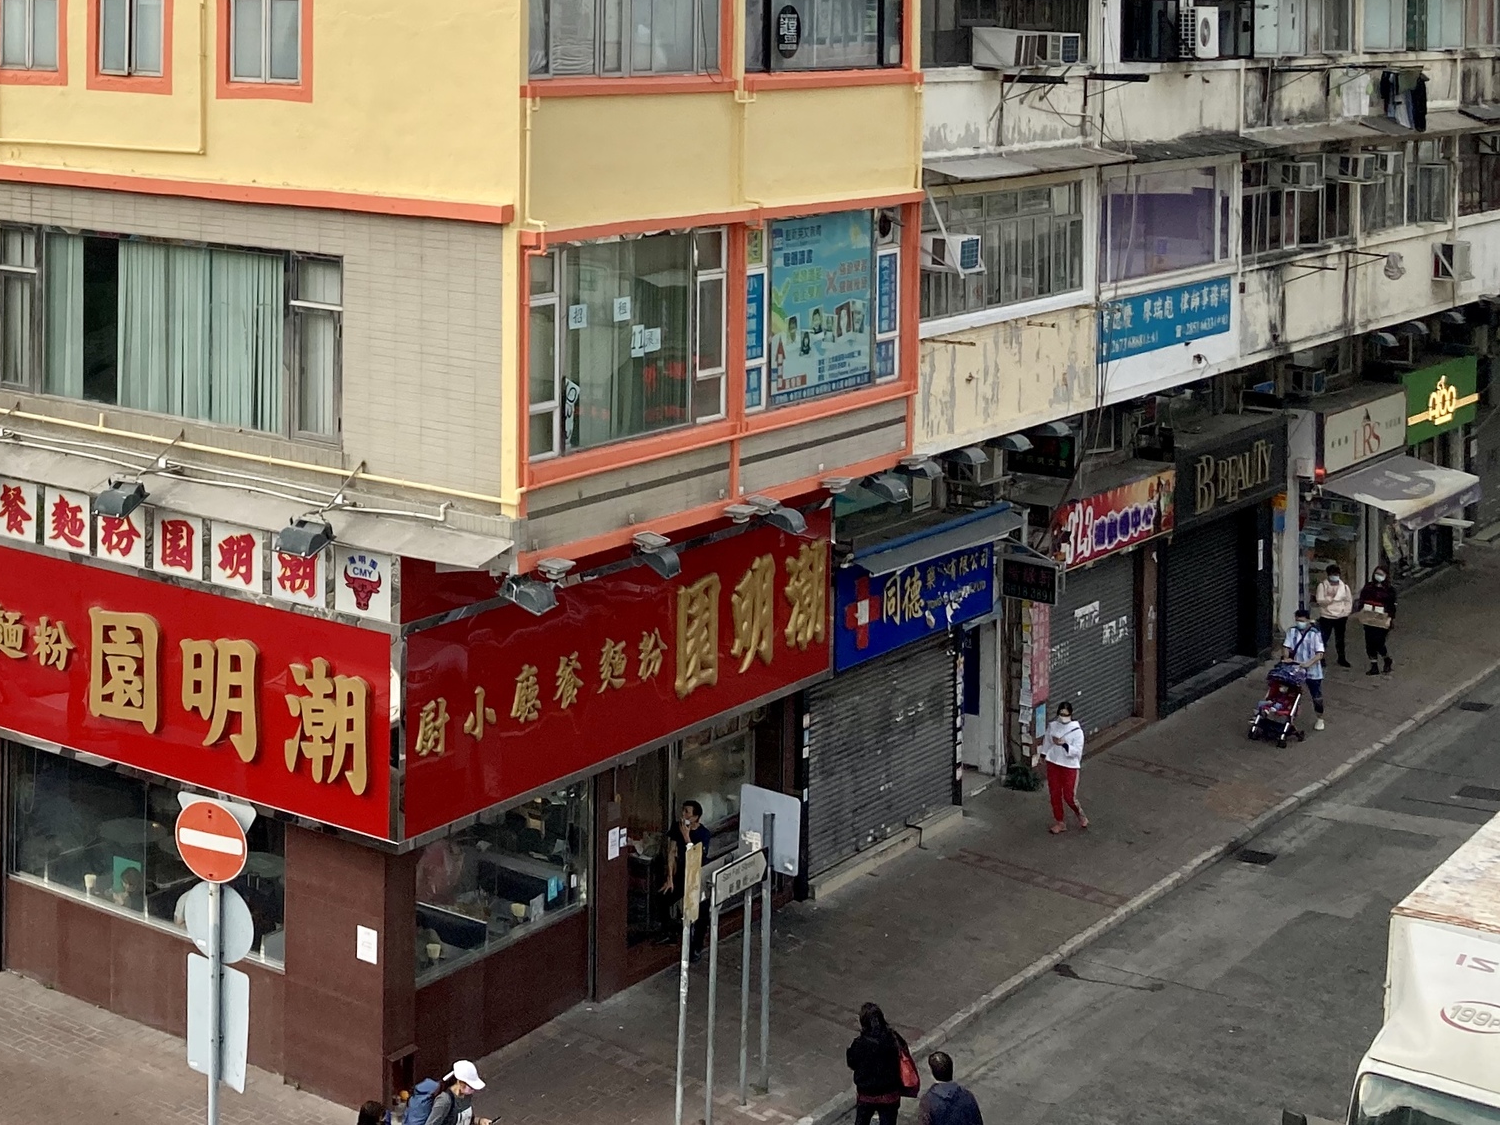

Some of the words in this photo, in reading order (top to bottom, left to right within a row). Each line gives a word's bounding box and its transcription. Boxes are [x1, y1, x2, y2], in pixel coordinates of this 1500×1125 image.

[1217, 439, 1274, 503] BEAUTY
[353, 567, 373, 578] CMY
[883, 566, 925, 625] 同德
[88, 607, 371, 796] 潮明園
